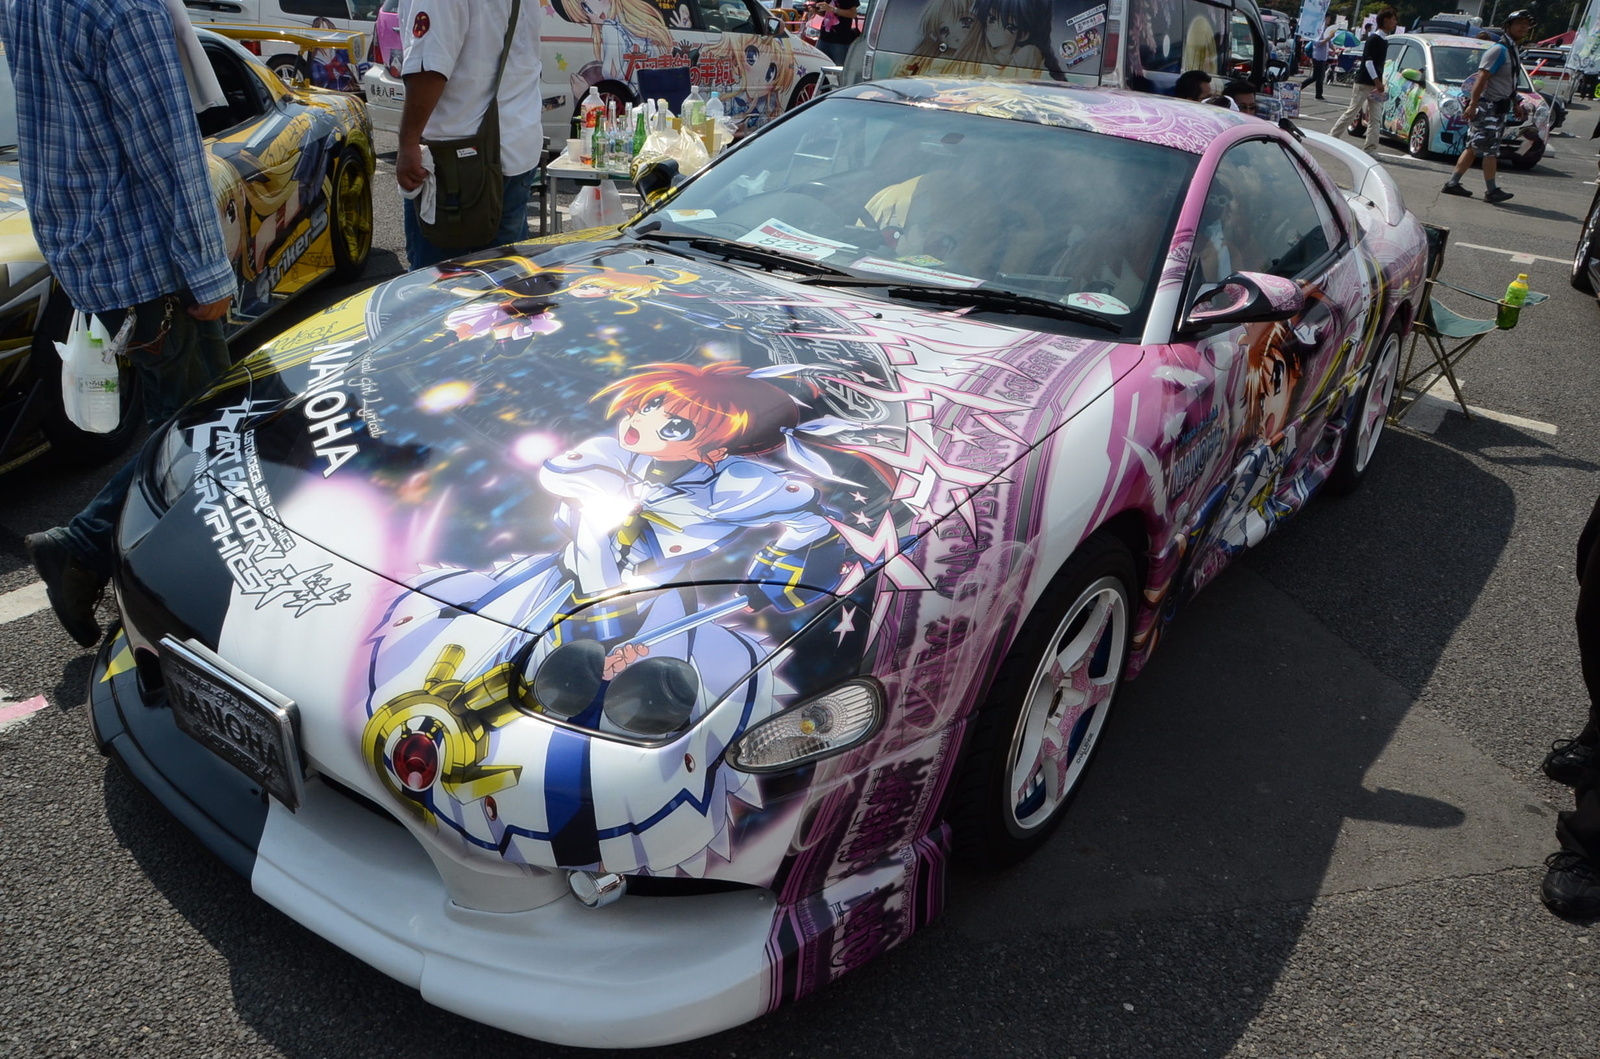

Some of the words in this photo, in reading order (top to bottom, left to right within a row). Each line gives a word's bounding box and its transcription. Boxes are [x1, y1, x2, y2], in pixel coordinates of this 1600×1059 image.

[758, 237, 818, 252] 828
[215, 430, 243, 467] ART
[303, 340, 360, 479] NANOHA
[356, 396, 389, 439] Lyrical
[193, 471, 267, 595] GRAPHICS
[218, 466, 286, 561] FACTORY
[167, 677, 285, 770] NANOHA
